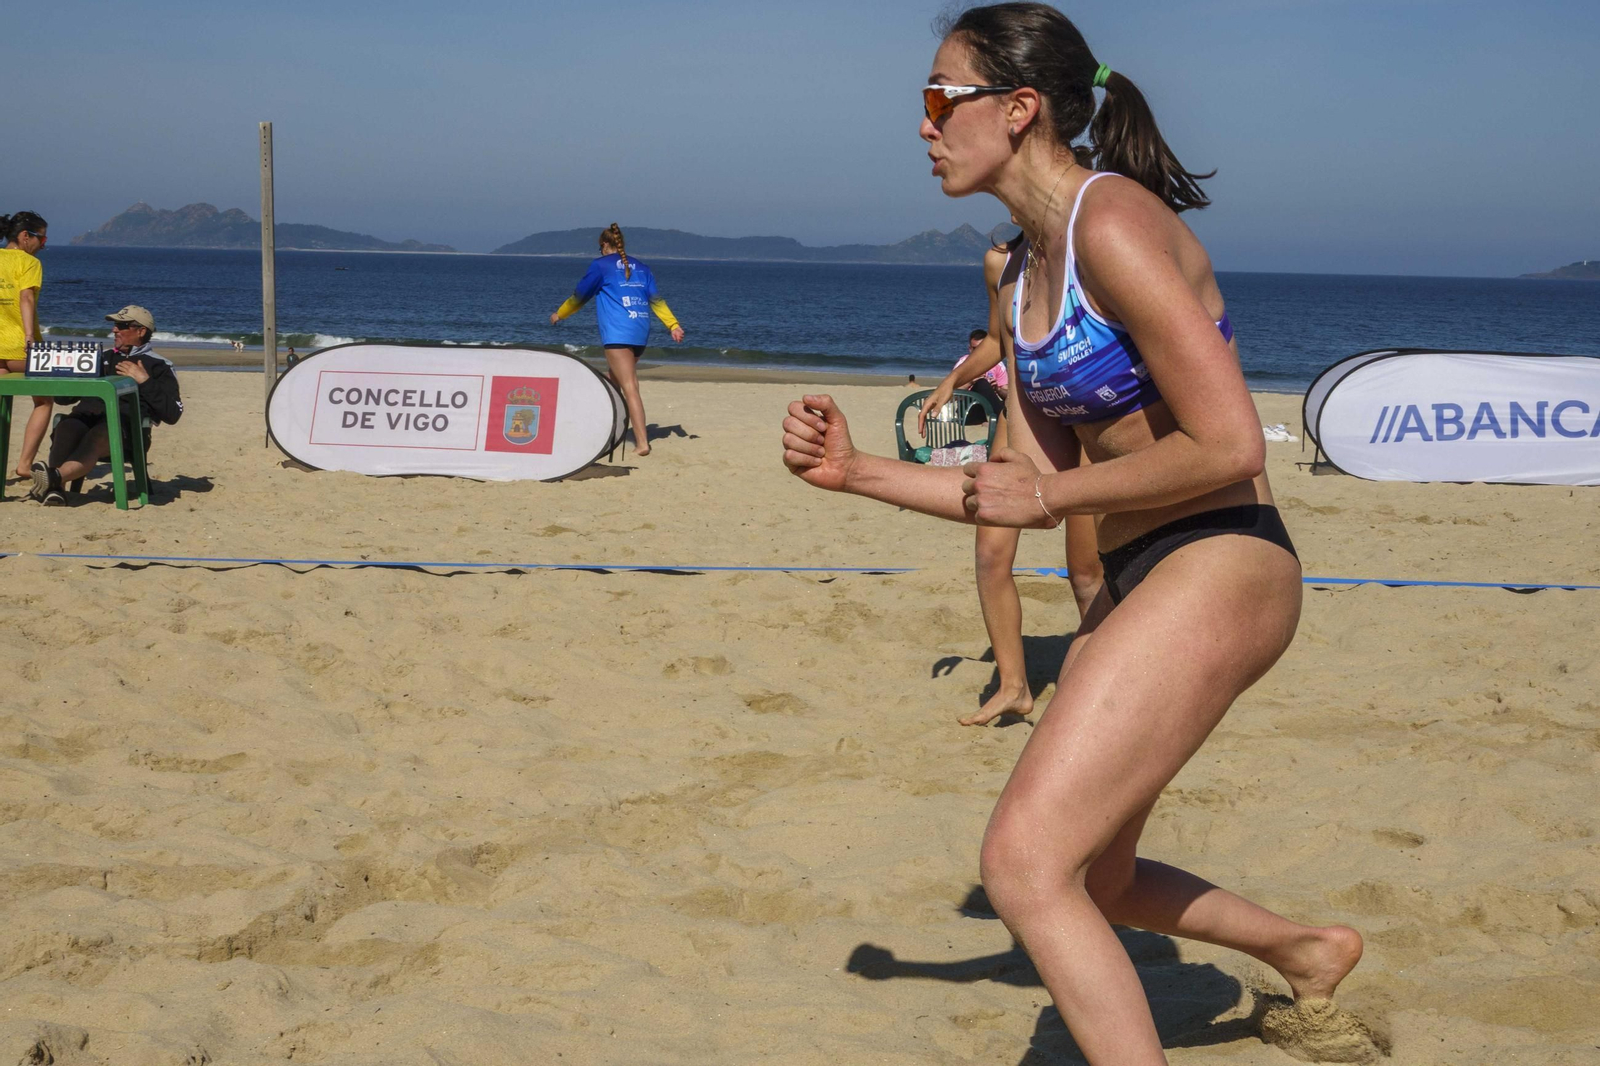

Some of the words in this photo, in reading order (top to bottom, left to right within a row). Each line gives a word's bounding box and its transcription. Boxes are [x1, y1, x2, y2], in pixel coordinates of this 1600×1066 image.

[33, 352, 51, 371] 12
[55, 355, 61, 365] 1
[65, 355, 73, 366] 0
[77, 354, 94, 372] 6
[1068, 346, 1093, 365] VOLLEY
[1028, 360, 1041, 388] 2
[328, 387, 468, 409] CONCELLO
[1029, 384, 1071, 403] FIGUEROA
[341, 411, 376, 430] DE
[386, 412, 449, 432] VIGO
